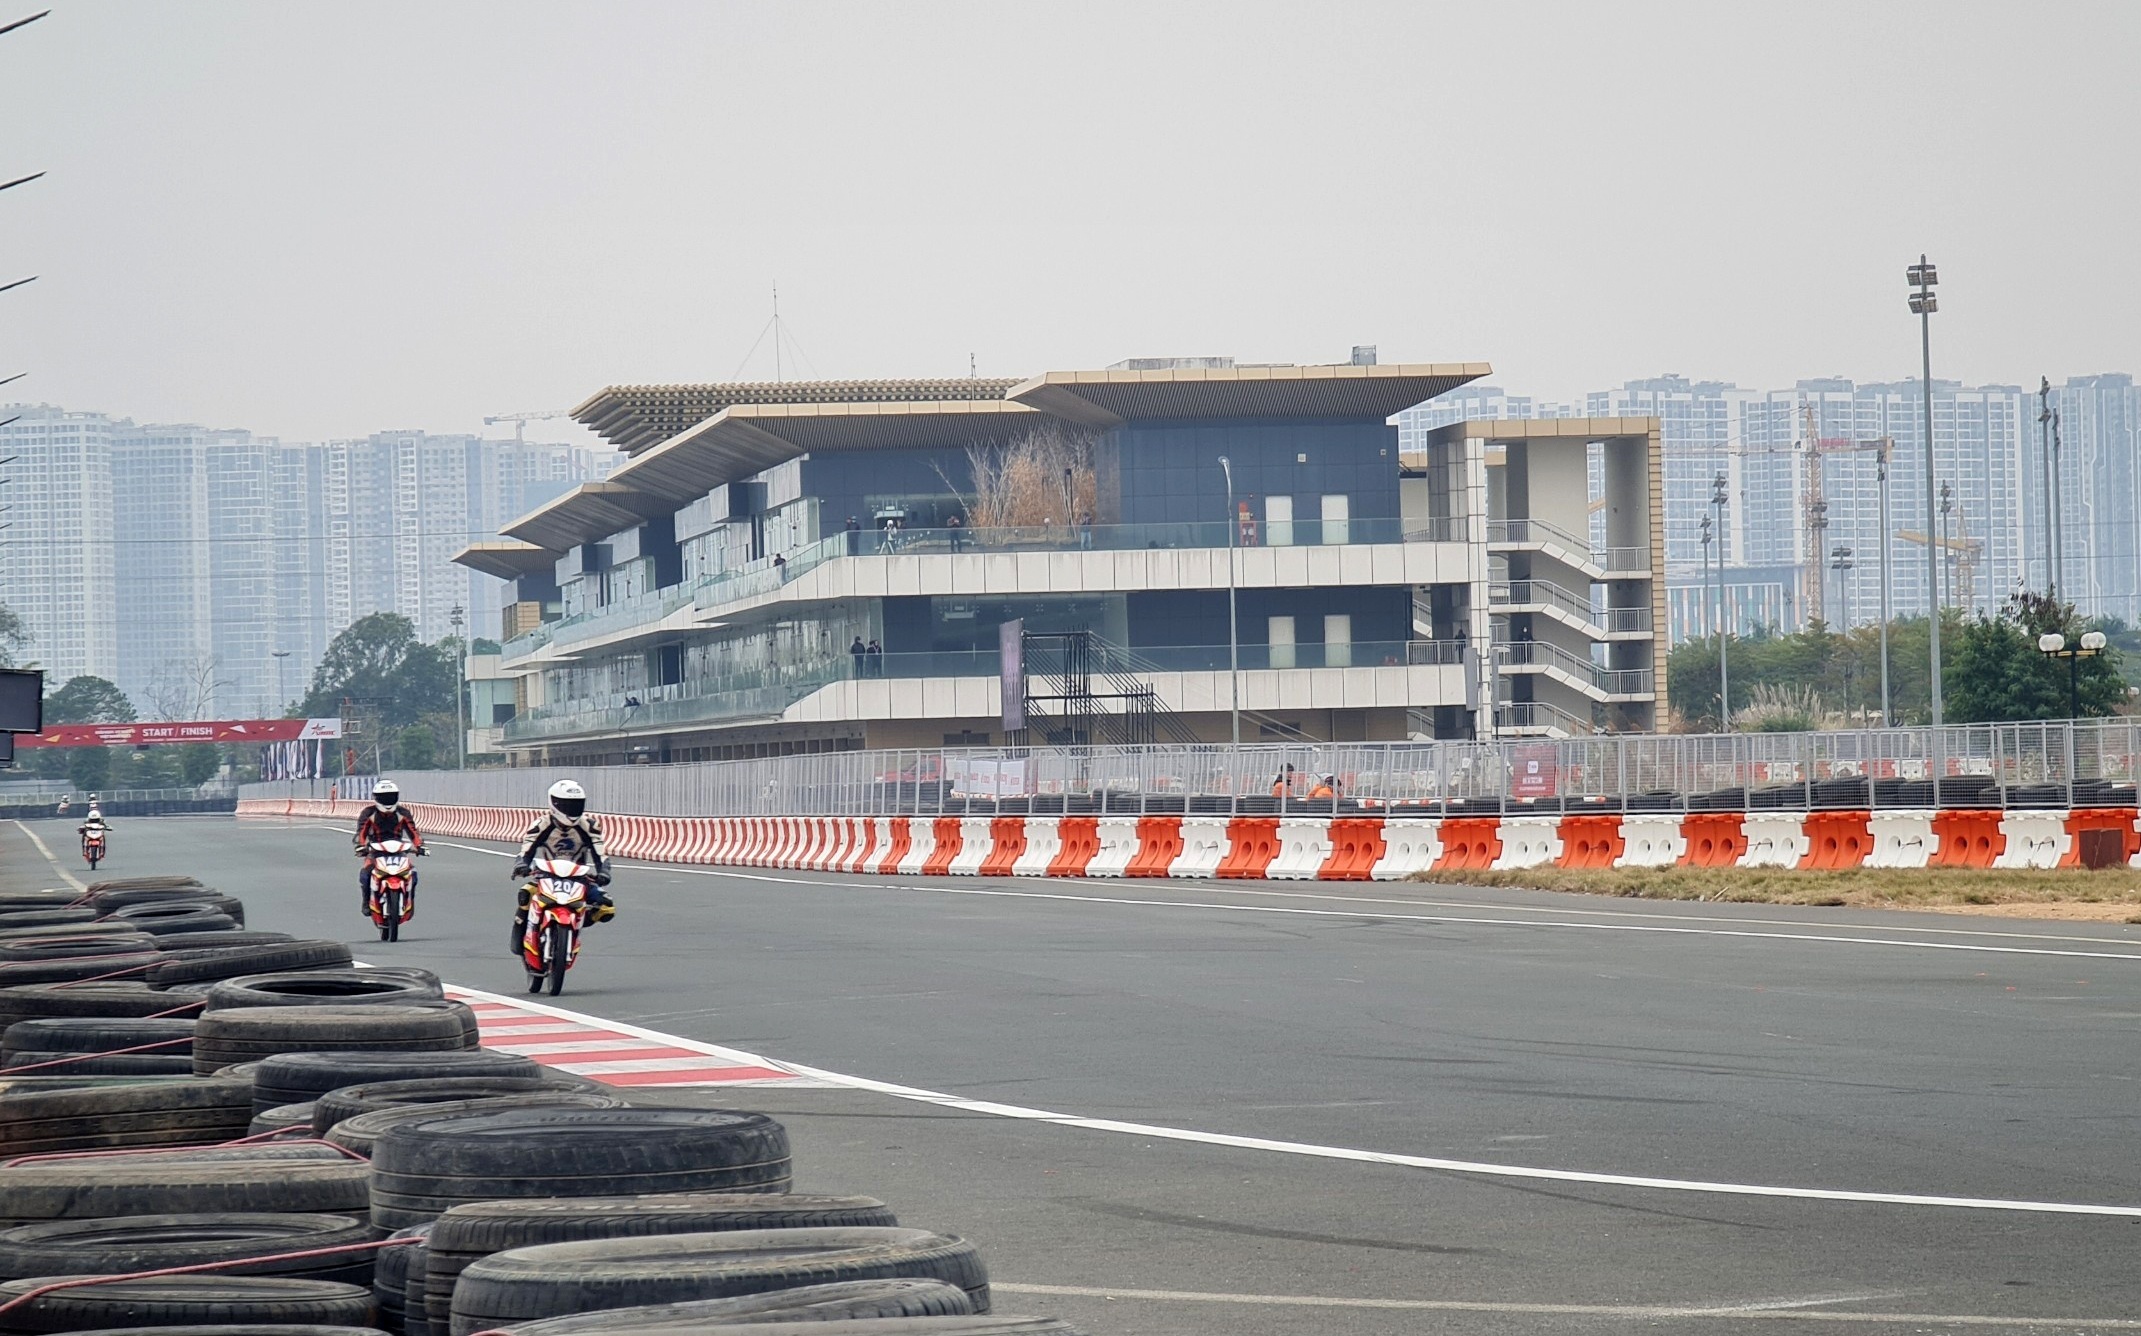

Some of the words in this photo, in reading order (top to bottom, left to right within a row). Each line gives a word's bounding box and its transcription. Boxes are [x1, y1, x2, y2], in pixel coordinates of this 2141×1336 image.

[142, 728, 174, 736] START
[181, 727, 213, 736] FINISH
[386, 856, 399, 864] 44
[554, 881, 571, 892] 20
